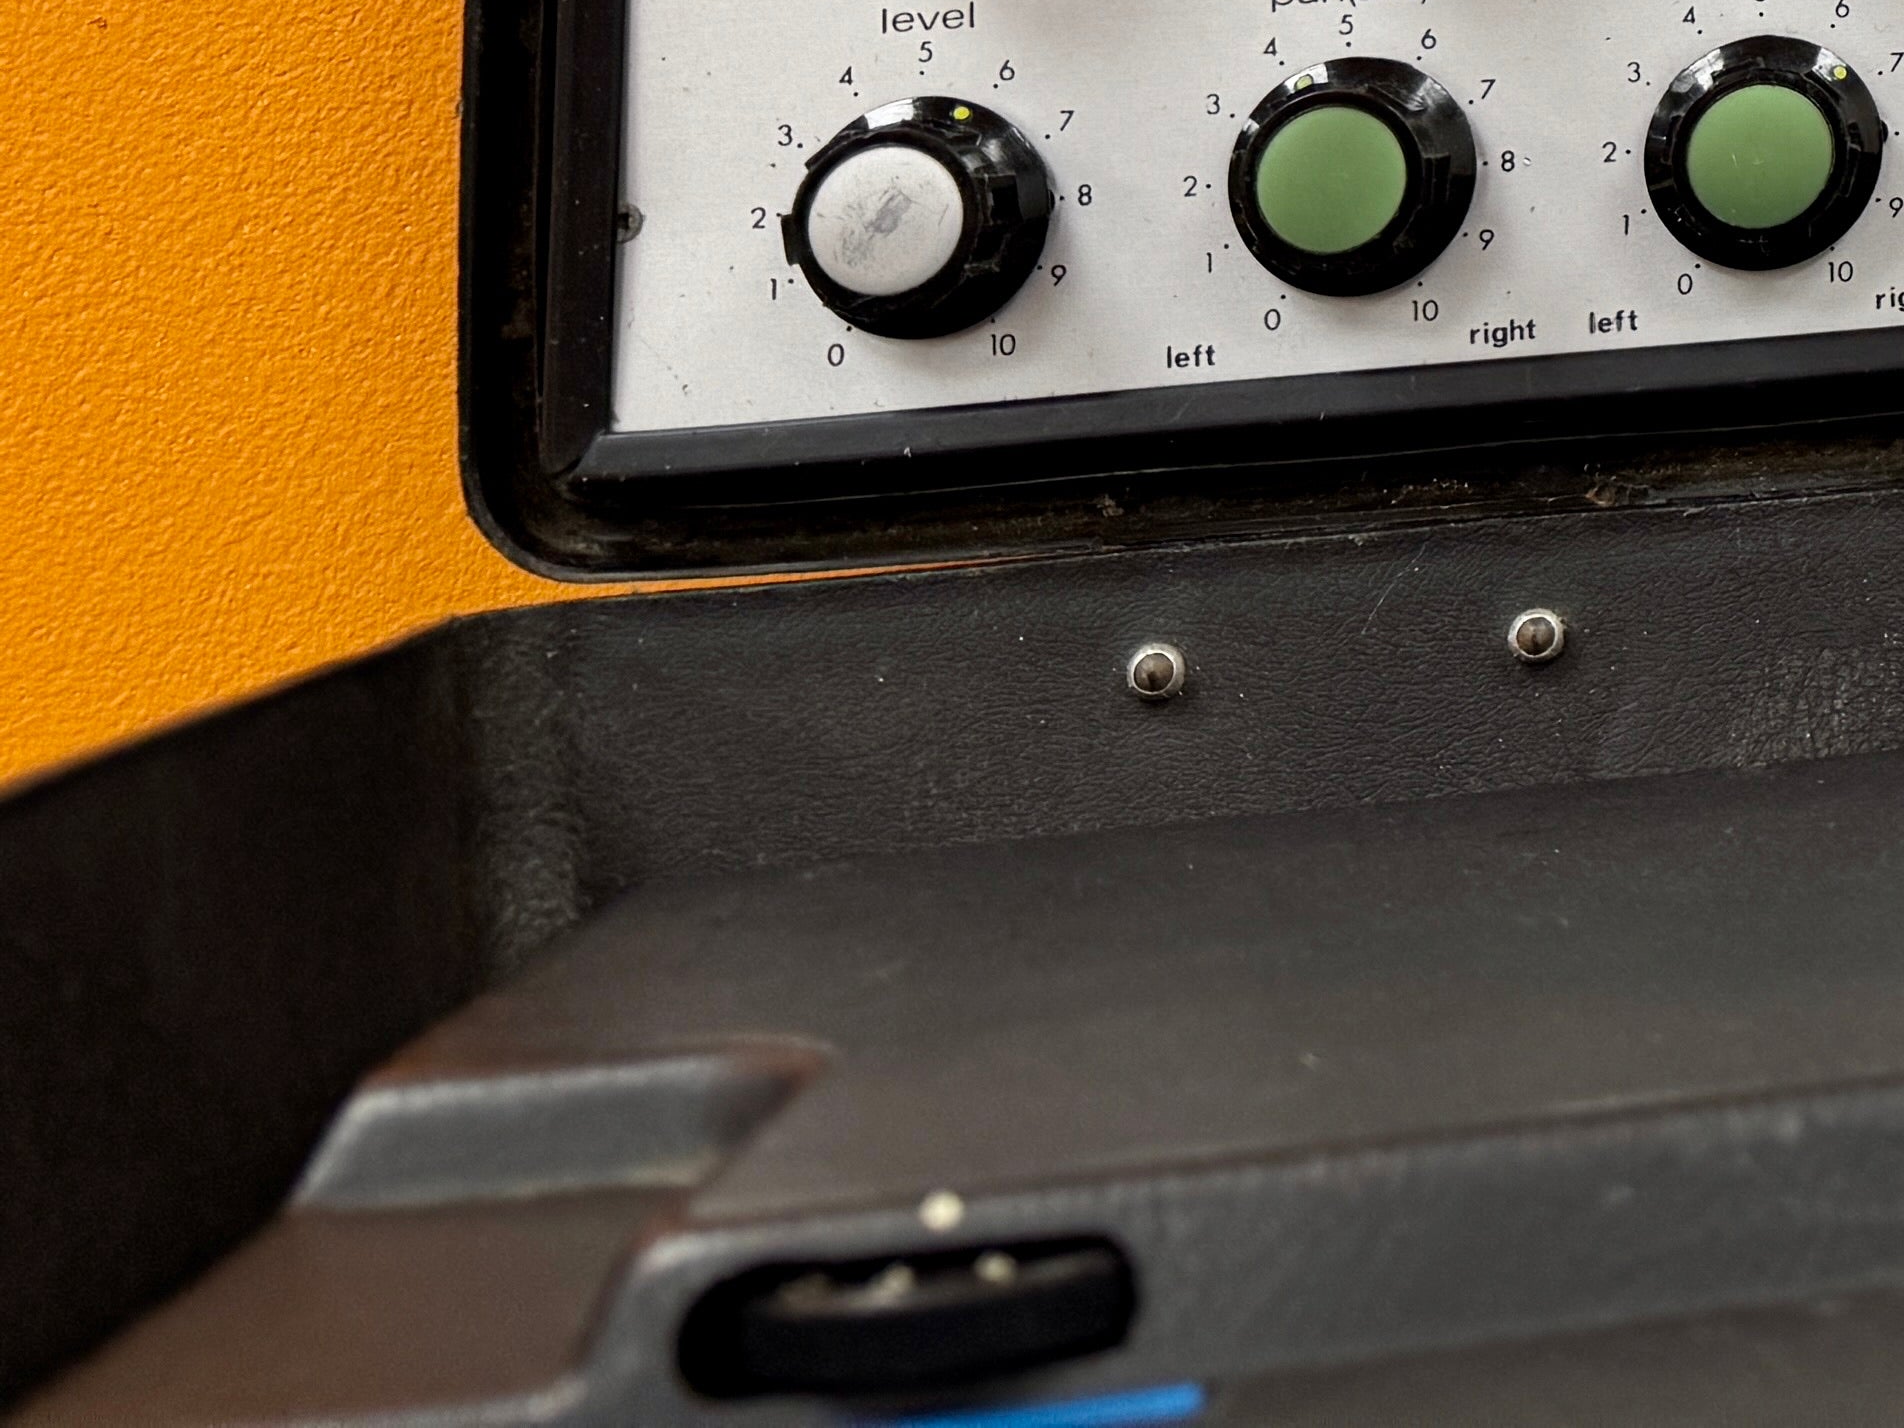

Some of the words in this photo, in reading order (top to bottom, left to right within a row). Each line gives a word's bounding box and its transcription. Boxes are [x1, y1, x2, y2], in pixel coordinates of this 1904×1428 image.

[880, 0, 976, 35] level
[1468, 317, 1538, 350] right
[1165, 343, 1217, 370] left
